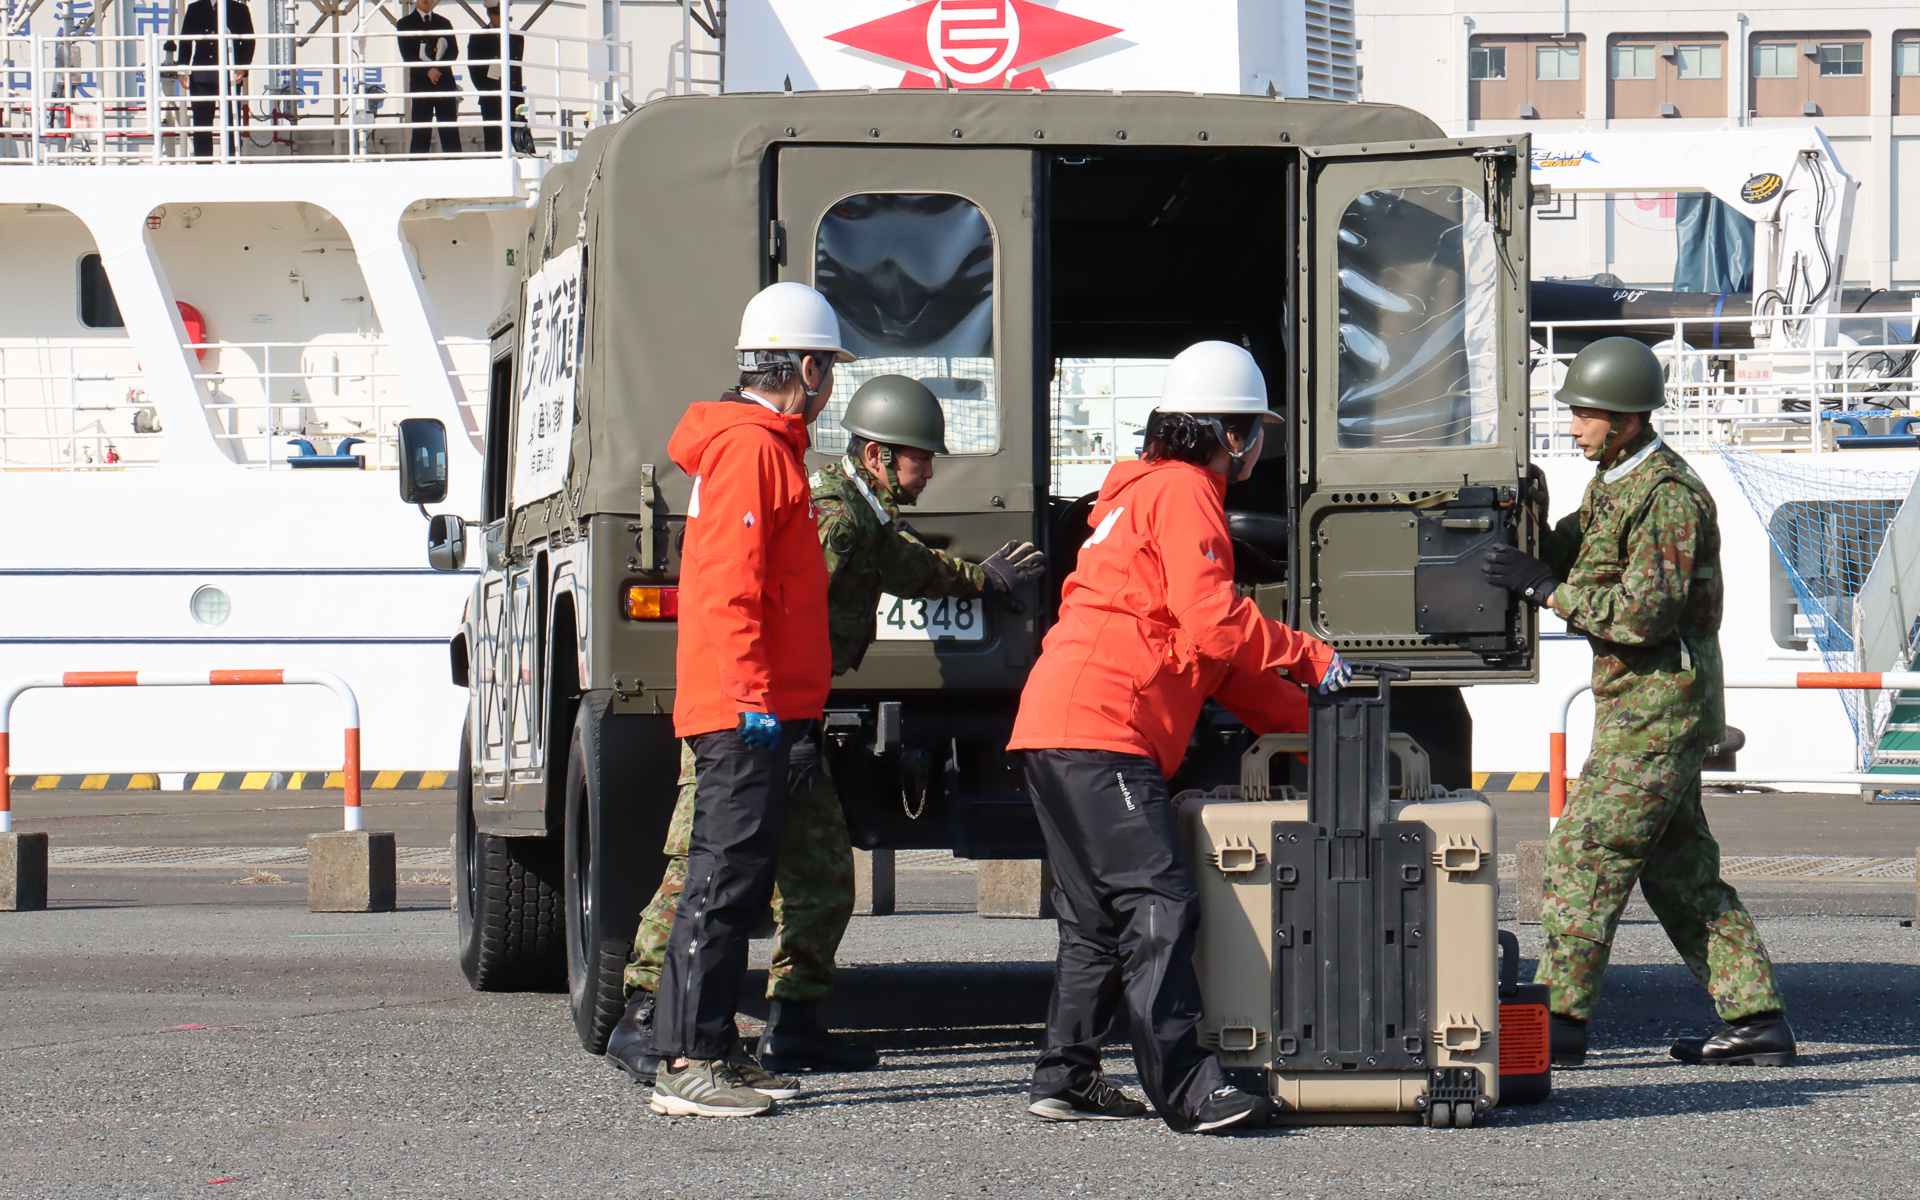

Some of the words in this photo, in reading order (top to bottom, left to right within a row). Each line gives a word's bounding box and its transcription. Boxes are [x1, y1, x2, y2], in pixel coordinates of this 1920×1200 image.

[1539, 160, 1582, 168] CRANE
[1738, 369, 1771, 379] 頭上注意
